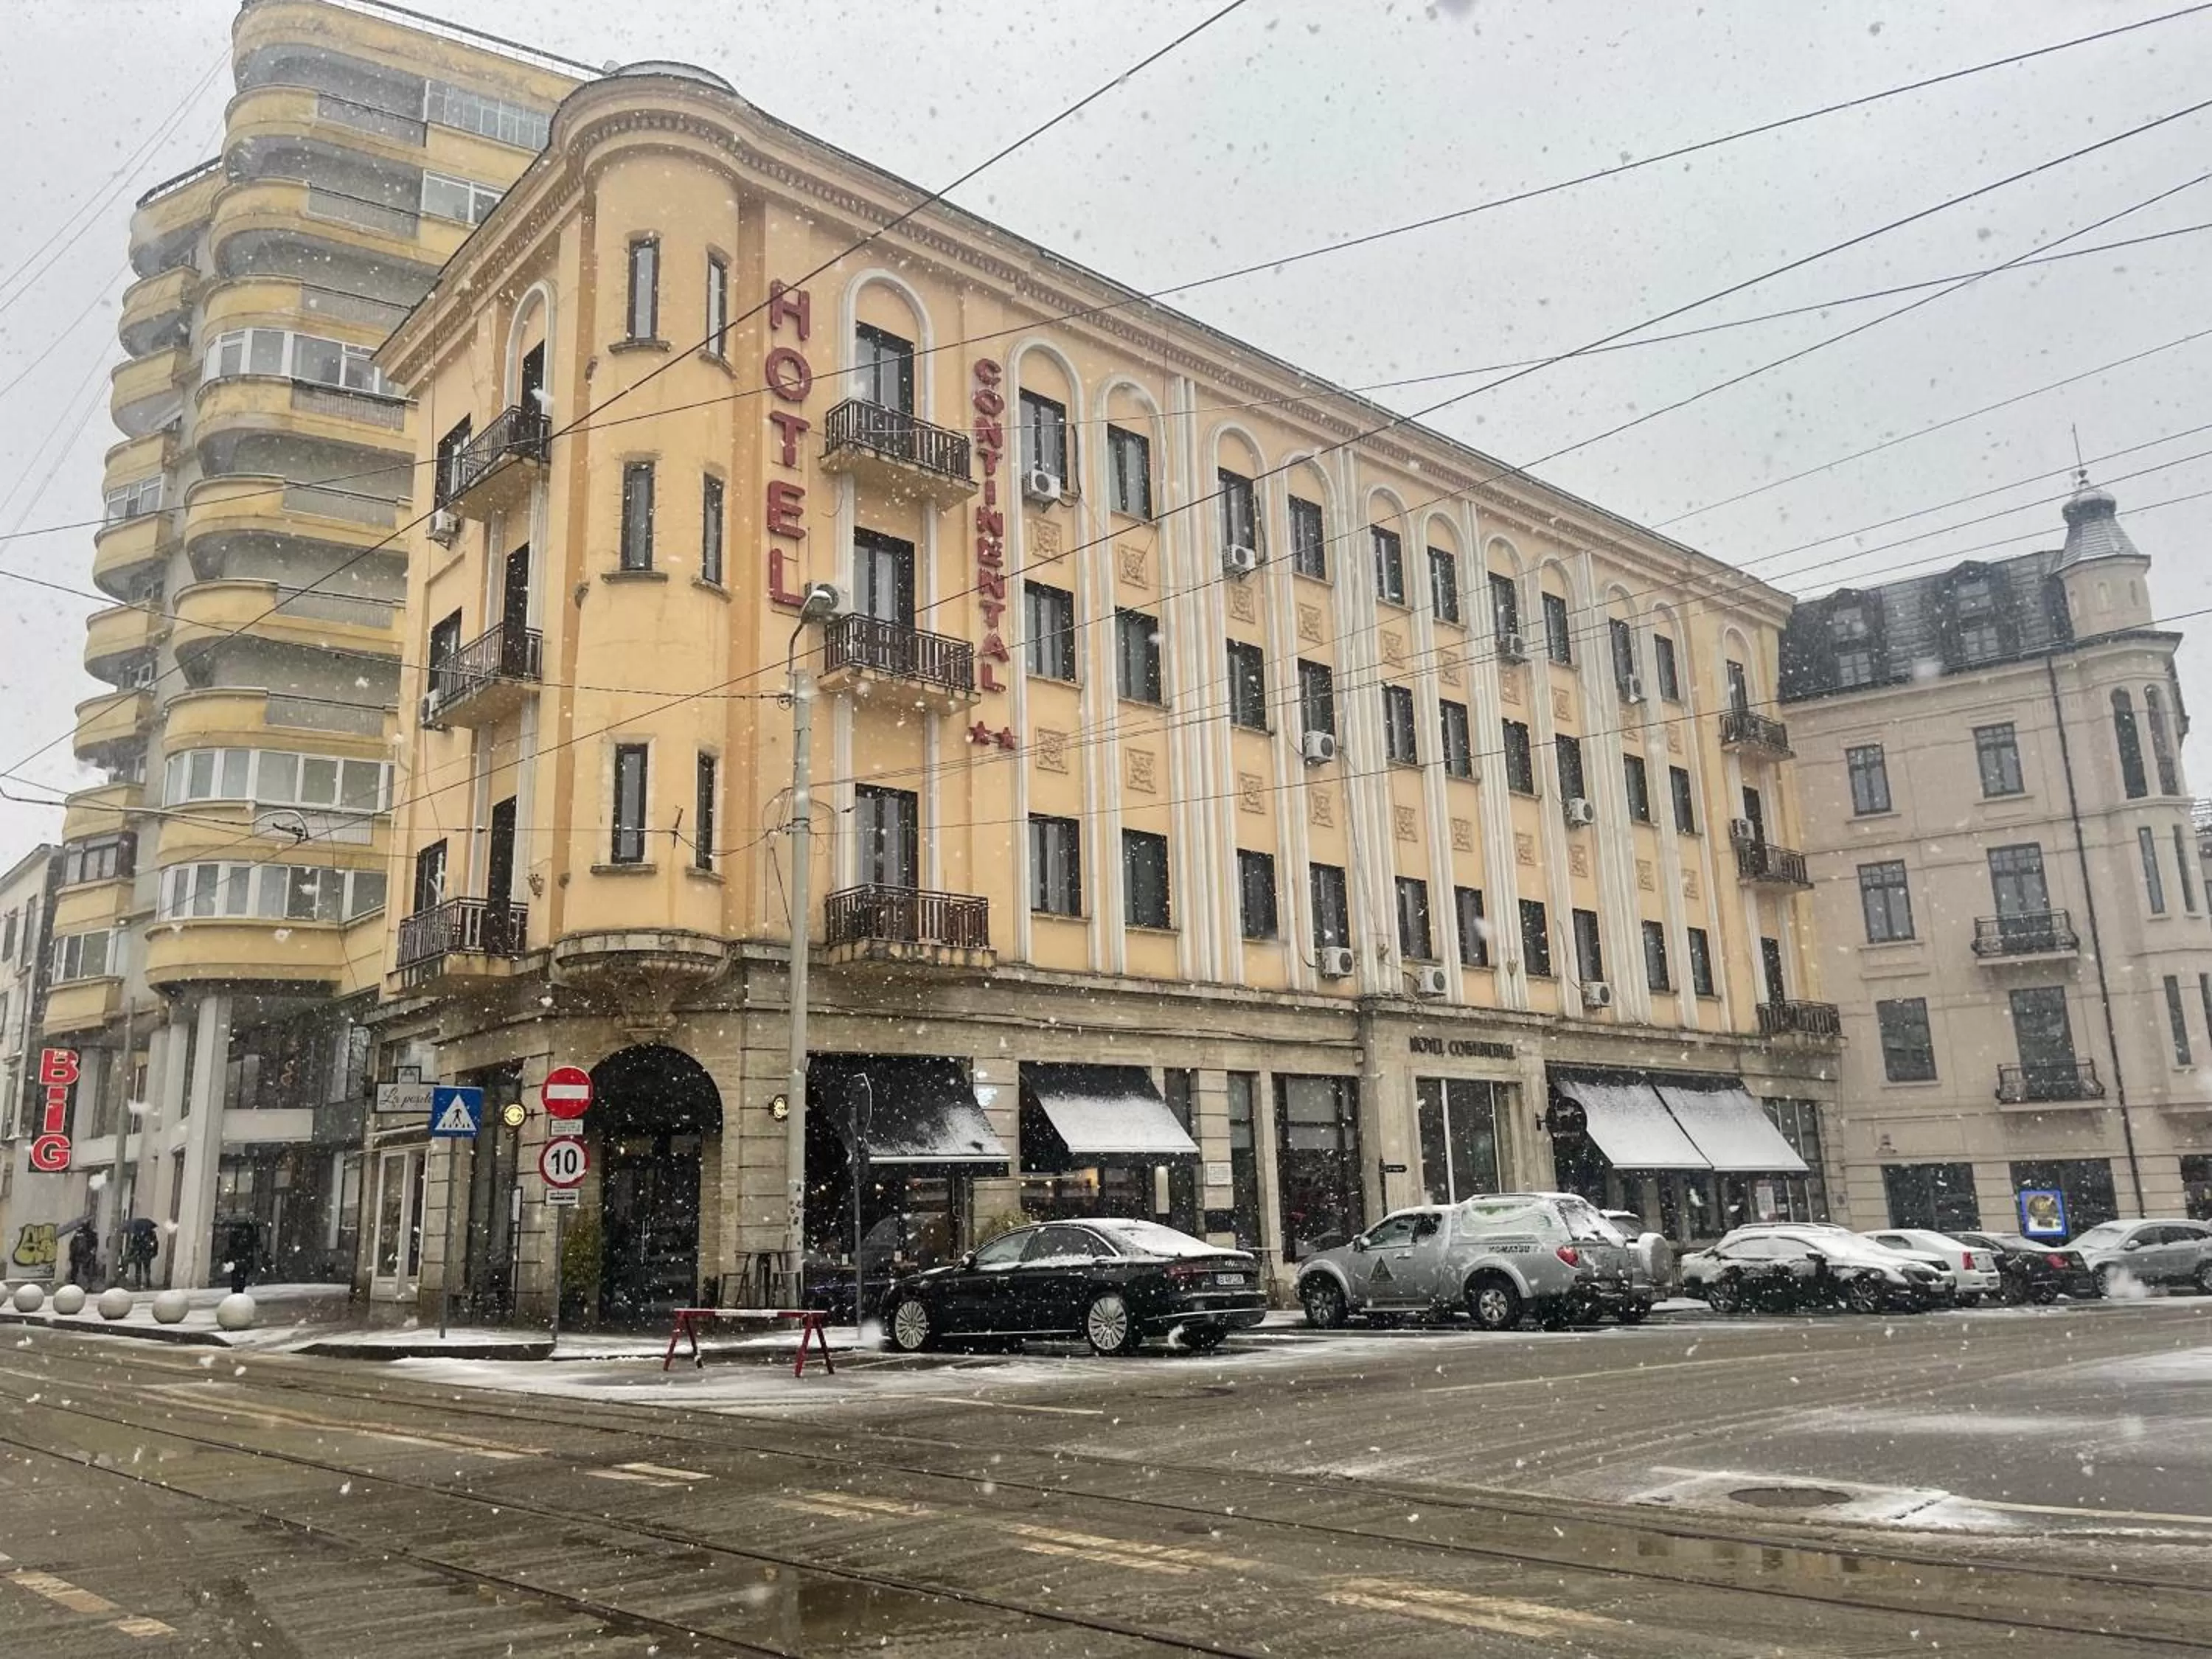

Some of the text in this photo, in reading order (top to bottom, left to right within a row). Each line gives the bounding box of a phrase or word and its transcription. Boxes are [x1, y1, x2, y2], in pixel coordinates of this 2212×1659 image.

[765, 279, 812, 608] HOTEL
[973, 358, 1010, 693] CONTINENTAL
[551, 1149, 577, 1175] 10
